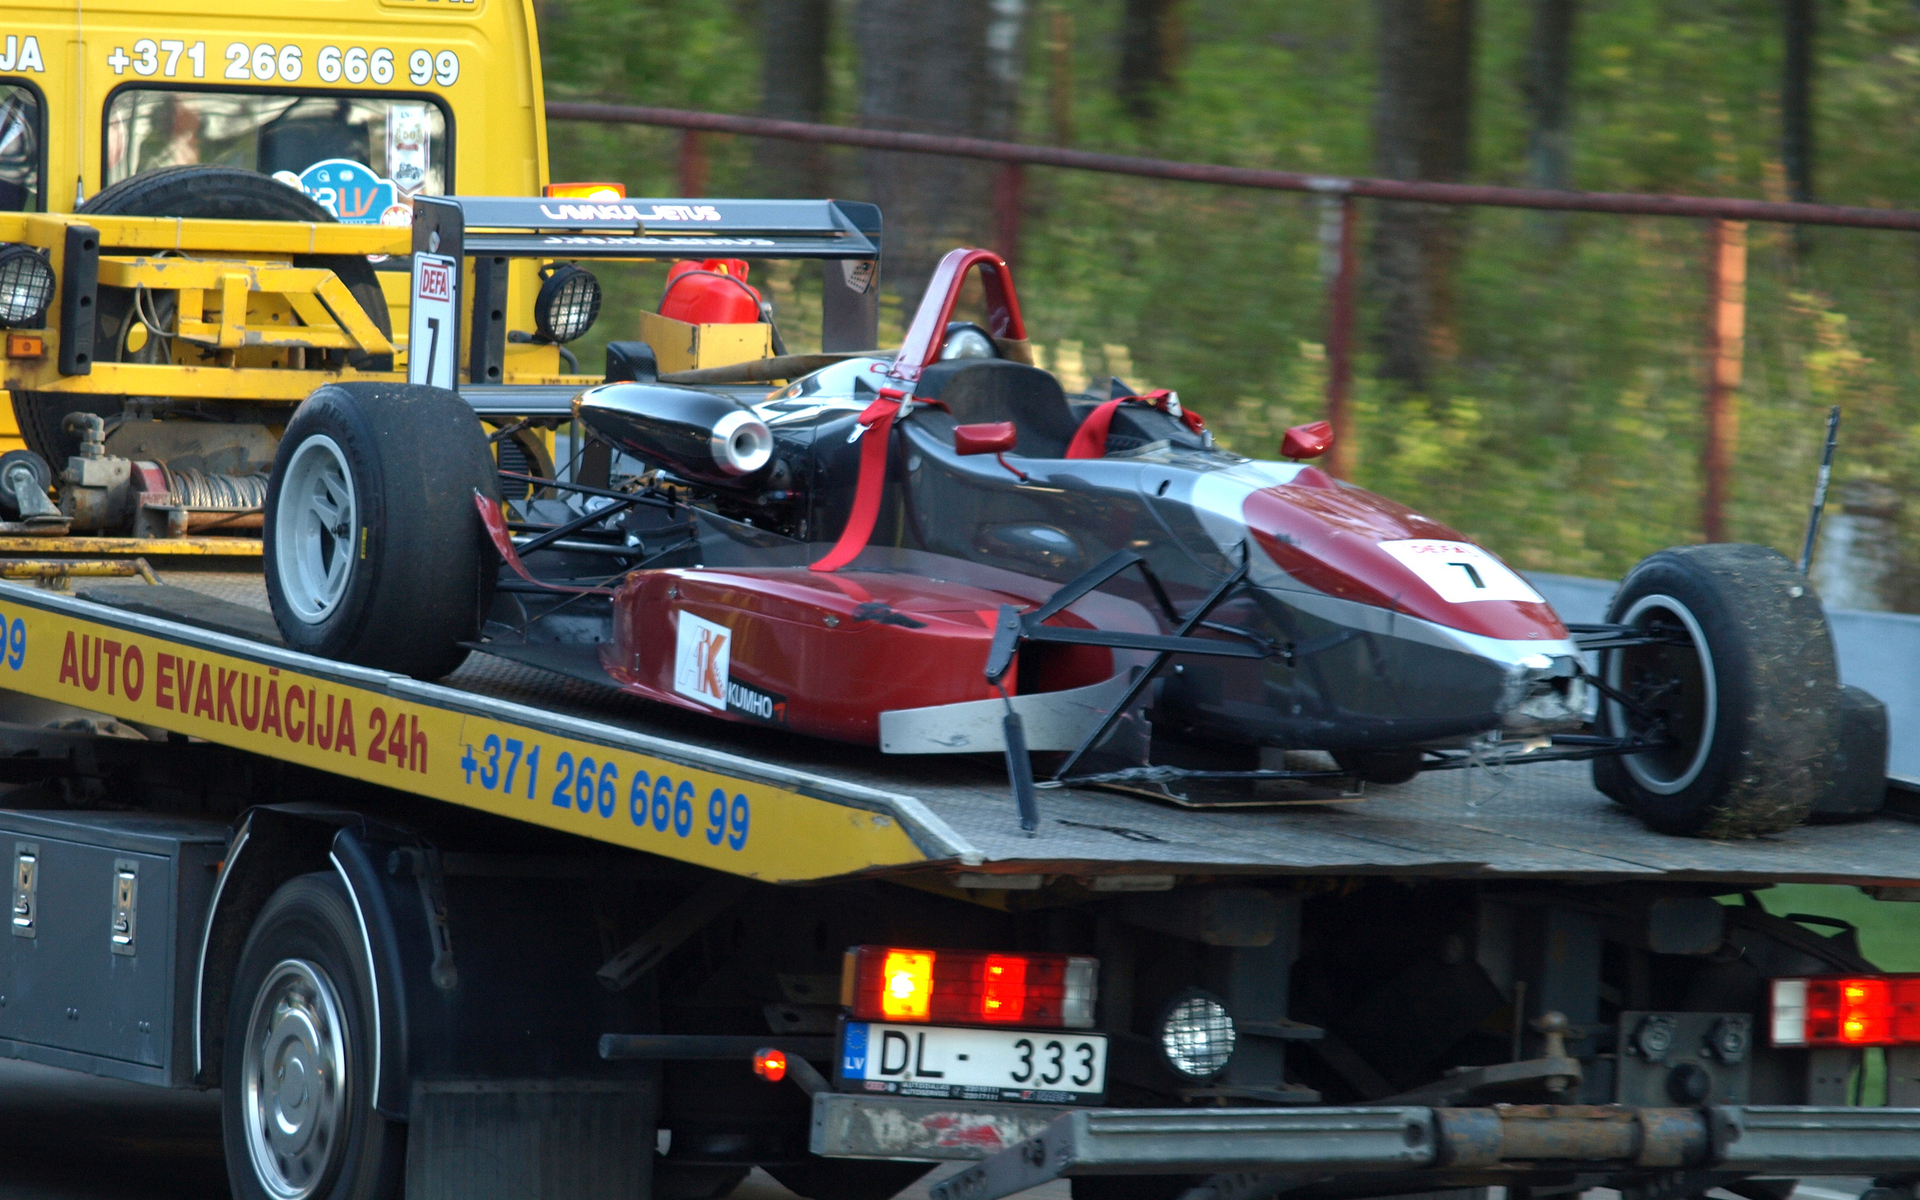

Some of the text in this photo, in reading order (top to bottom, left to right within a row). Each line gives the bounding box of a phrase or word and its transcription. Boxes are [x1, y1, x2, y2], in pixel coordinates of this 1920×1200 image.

[107, 38, 460, 87] +371 266 666 99
[422, 269, 447, 296] DEFA
[426, 317, 440, 385] 7
[1445, 562, 1486, 589] 7
[59, 630, 428, 774] AUTO EVAKUĀCIJA 24h
[728, 681, 773, 719] KUMHO
[460, 734, 750, 851] +371 266 666 99
[844, 1057, 865, 1071] LV
[1011, 1038, 1096, 1087] 333
